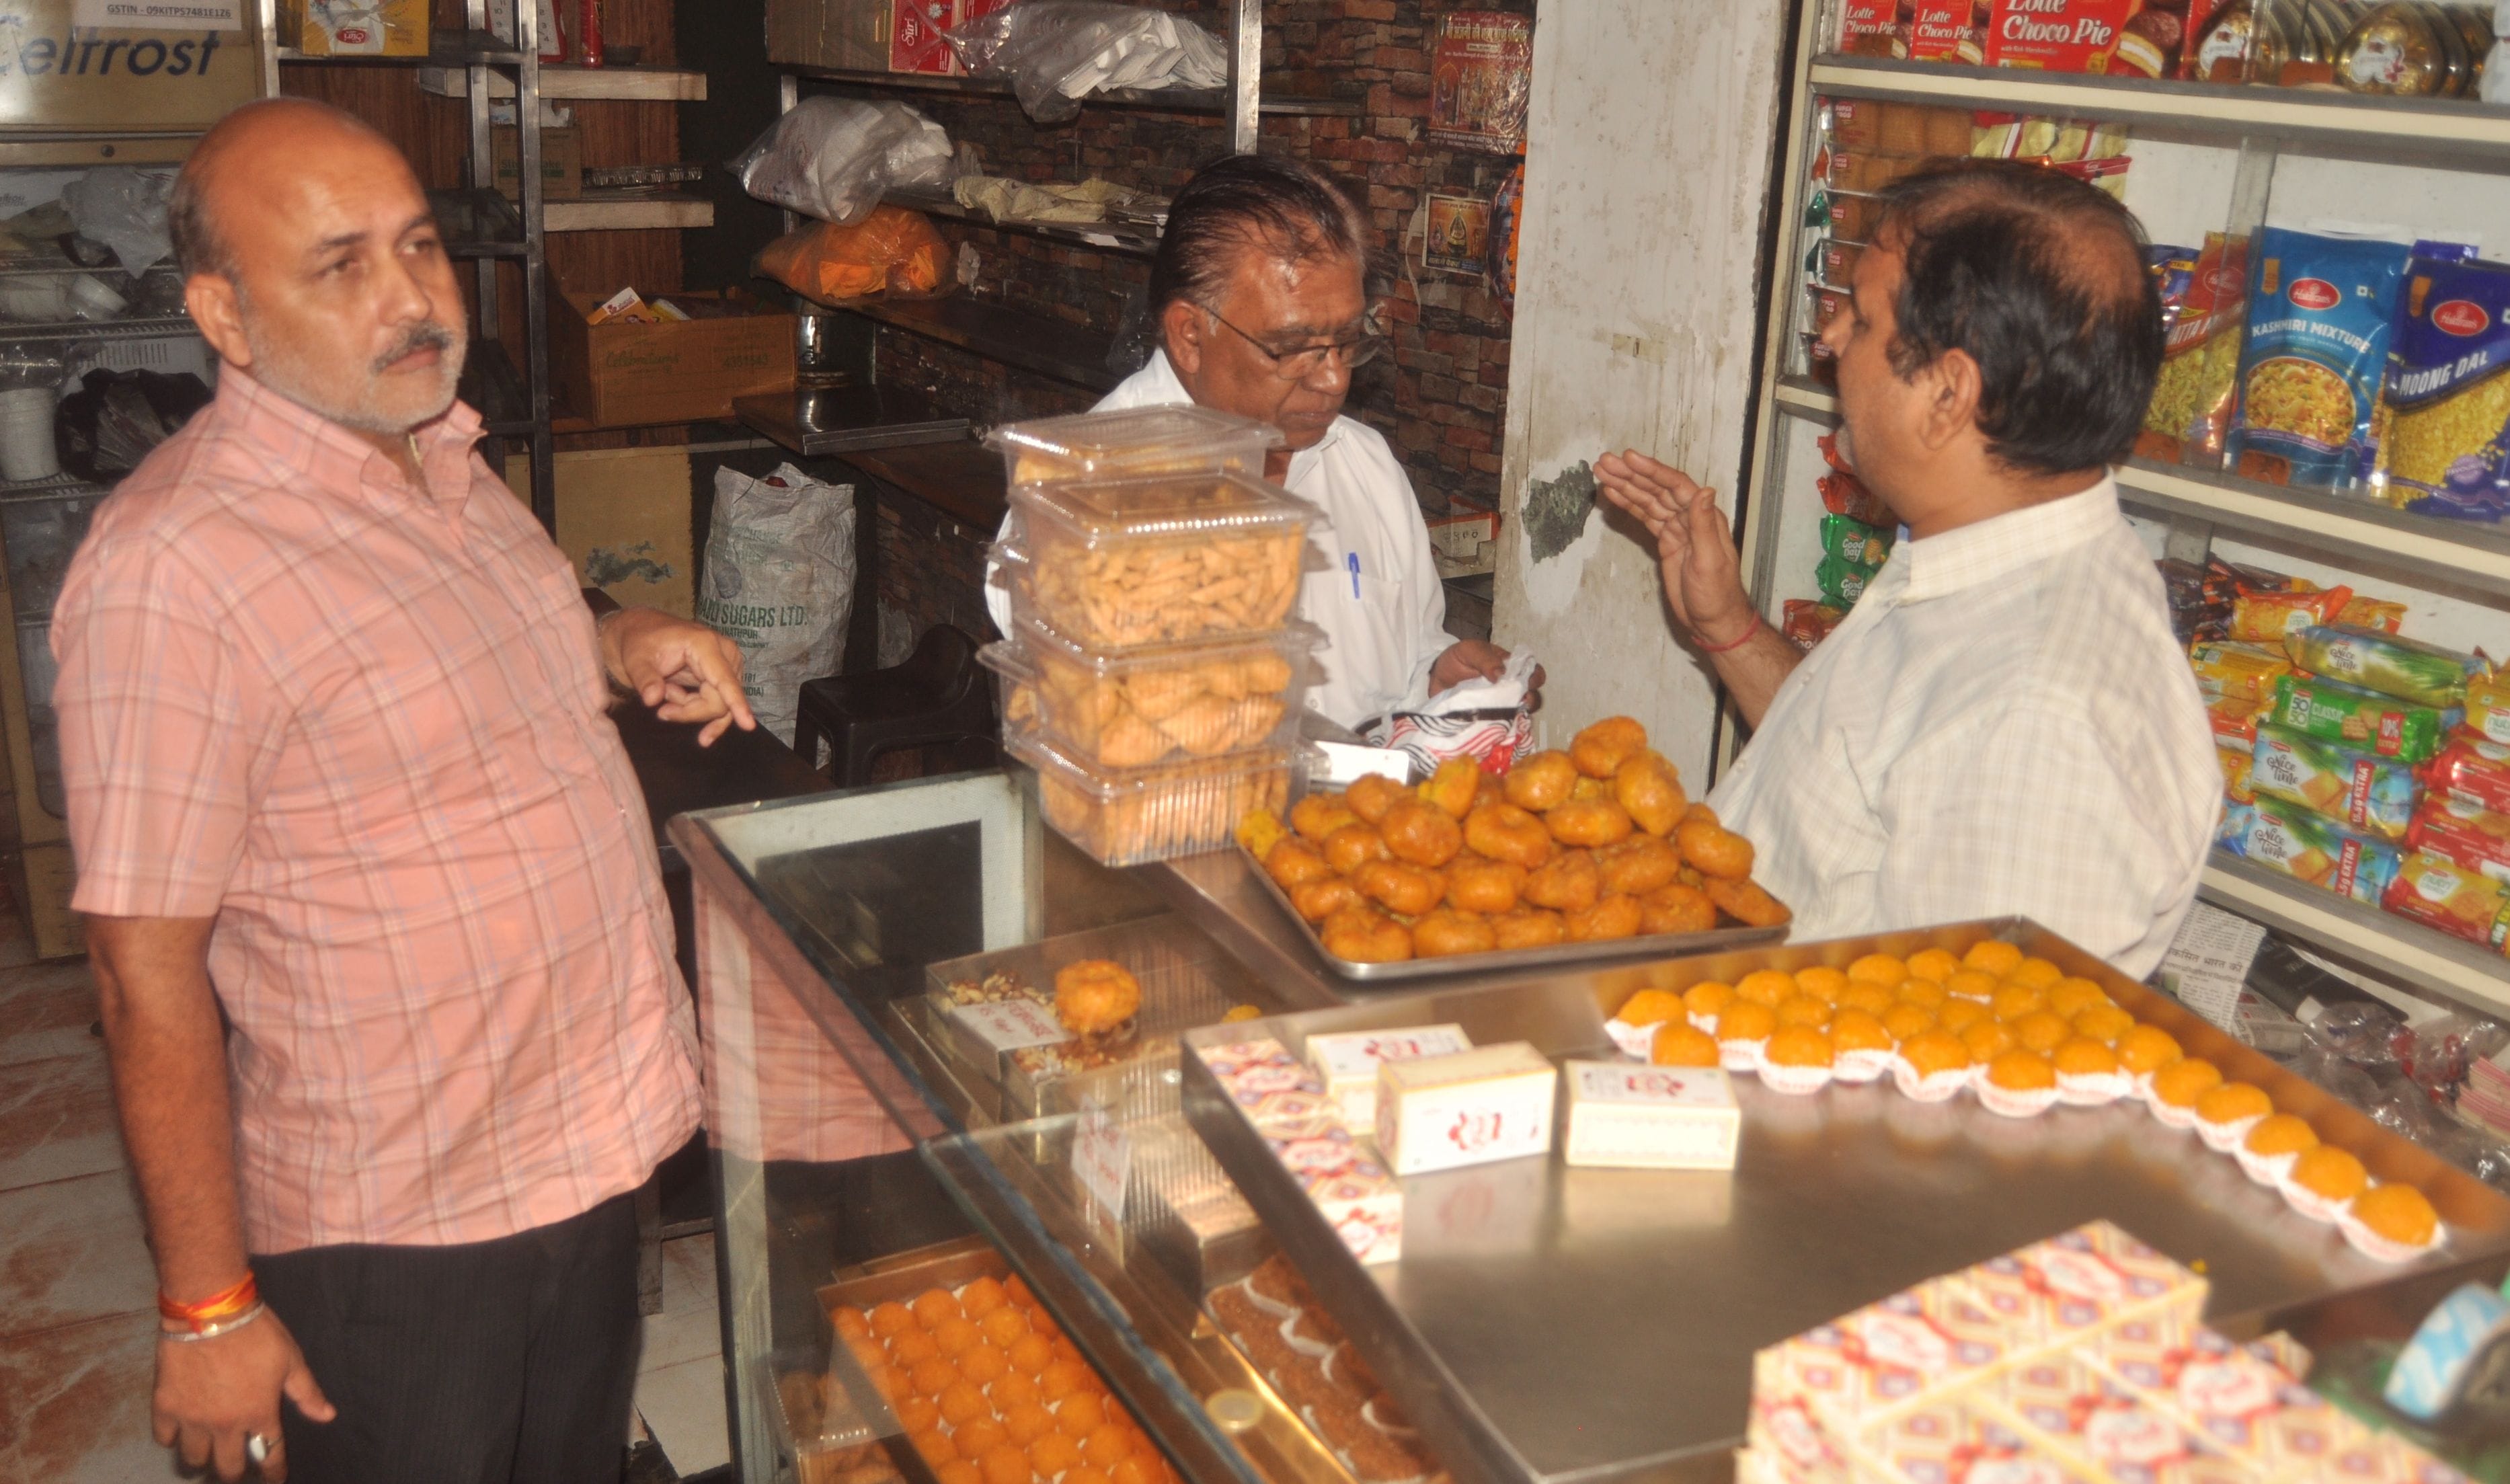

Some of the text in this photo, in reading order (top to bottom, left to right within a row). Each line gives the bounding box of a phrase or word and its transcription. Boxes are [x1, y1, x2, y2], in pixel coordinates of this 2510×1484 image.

[107, 5, 137, 15] GSTIN
[1847, 5, 1875, 19] Lotte
[1920, 9, 1951, 23] Lotte
[1844, 21, 1897, 34] Choco Pie
[1918, 25, 1973, 40] Choco Pie
[2003, 15, 2112, 45] Choco Pie
[3, 23, 221, 75] elfrost
[2252, 319, 2306, 337] KASHMIRI
[2310, 321, 2371, 354] MIXTURE
[2400, 350, 2488, 395] MOONG DAL
[1842, 539, 1866, 549] Good
[1841, 578, 1863, 590] Good
[721, 603, 775, 627] SUGARS
[779, 606, 808, 626] LTD.
[744, 672, 756, 682] 101
[743, 685, 764, 697] NDIA)
[2292, 697, 2309, 711] 50
[2267, 754, 2296, 773] Nice
[2273, 770, 2299, 786] Time
[2255, 828, 2285, 847] Nice
[2261, 843, 2287, 859] Time
[2203, 957, 2226, 969] भारत
[2228, 960, 2243, 973] की
